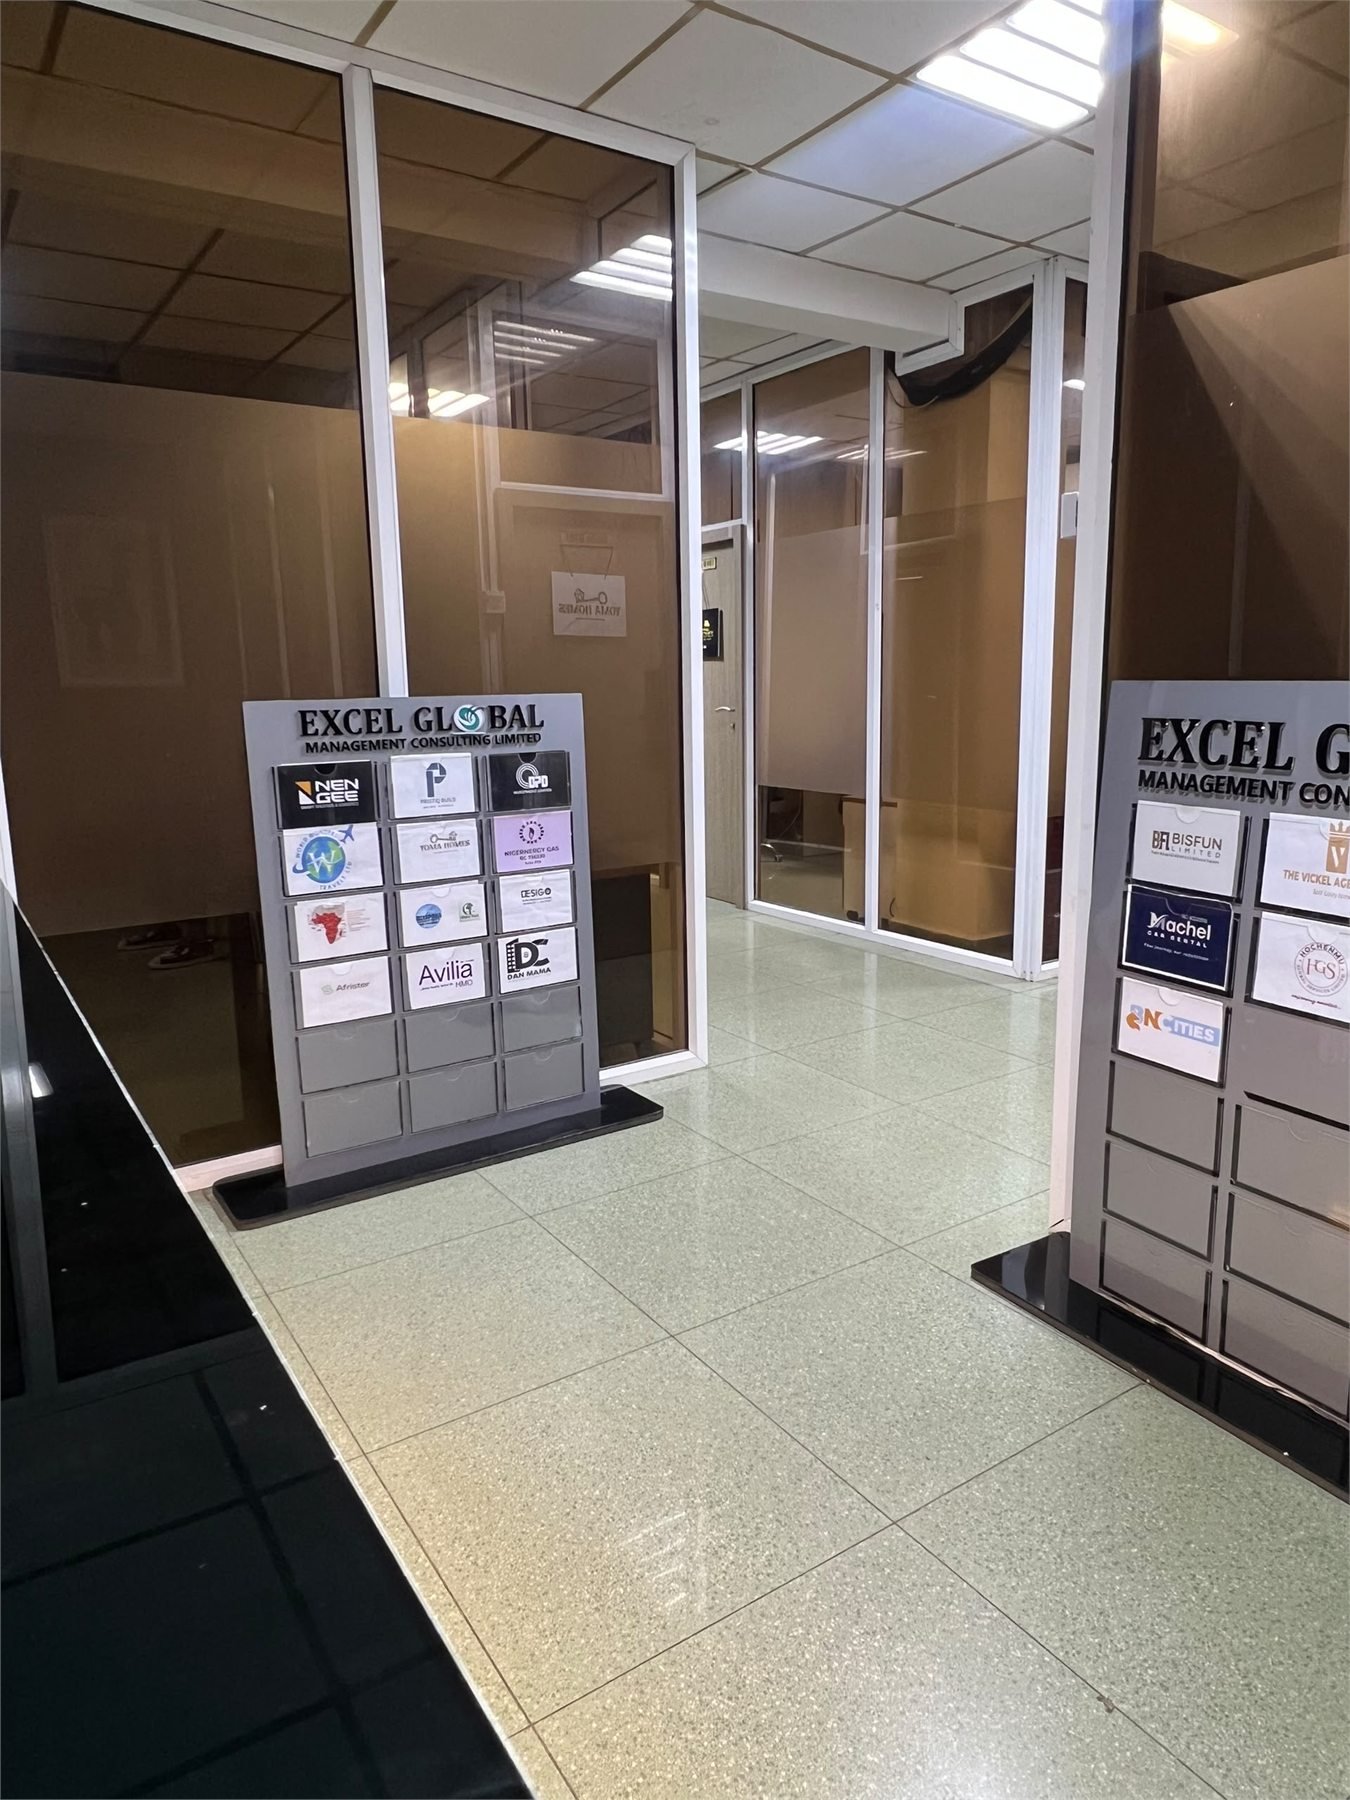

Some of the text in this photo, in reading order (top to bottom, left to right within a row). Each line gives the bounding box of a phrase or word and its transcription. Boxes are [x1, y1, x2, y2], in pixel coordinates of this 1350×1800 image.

[298, 708, 403, 737] EXCEL
[305, 732, 542, 754] MANAGEMENT CONSULTING LIMITED
[1137, 717, 1294, 771] EXCEL
[315, 778, 359, 792] NEN
[1137, 769, 1296, 800] MANAGEMENT
[316, 790, 359, 804] GEE
[1172, 832, 1222, 851] BISFUN
[1171, 846, 1221, 858] LIMITED
[1283, 869, 1299, 881] THE
[1301, 872, 1331, 886] VICKEL
[1147, 911, 1211, 940] Machel
[419, 960, 472, 986] Avilia
[507, 972, 525, 980] DAN
[526, 967, 551, 977] MAMA
